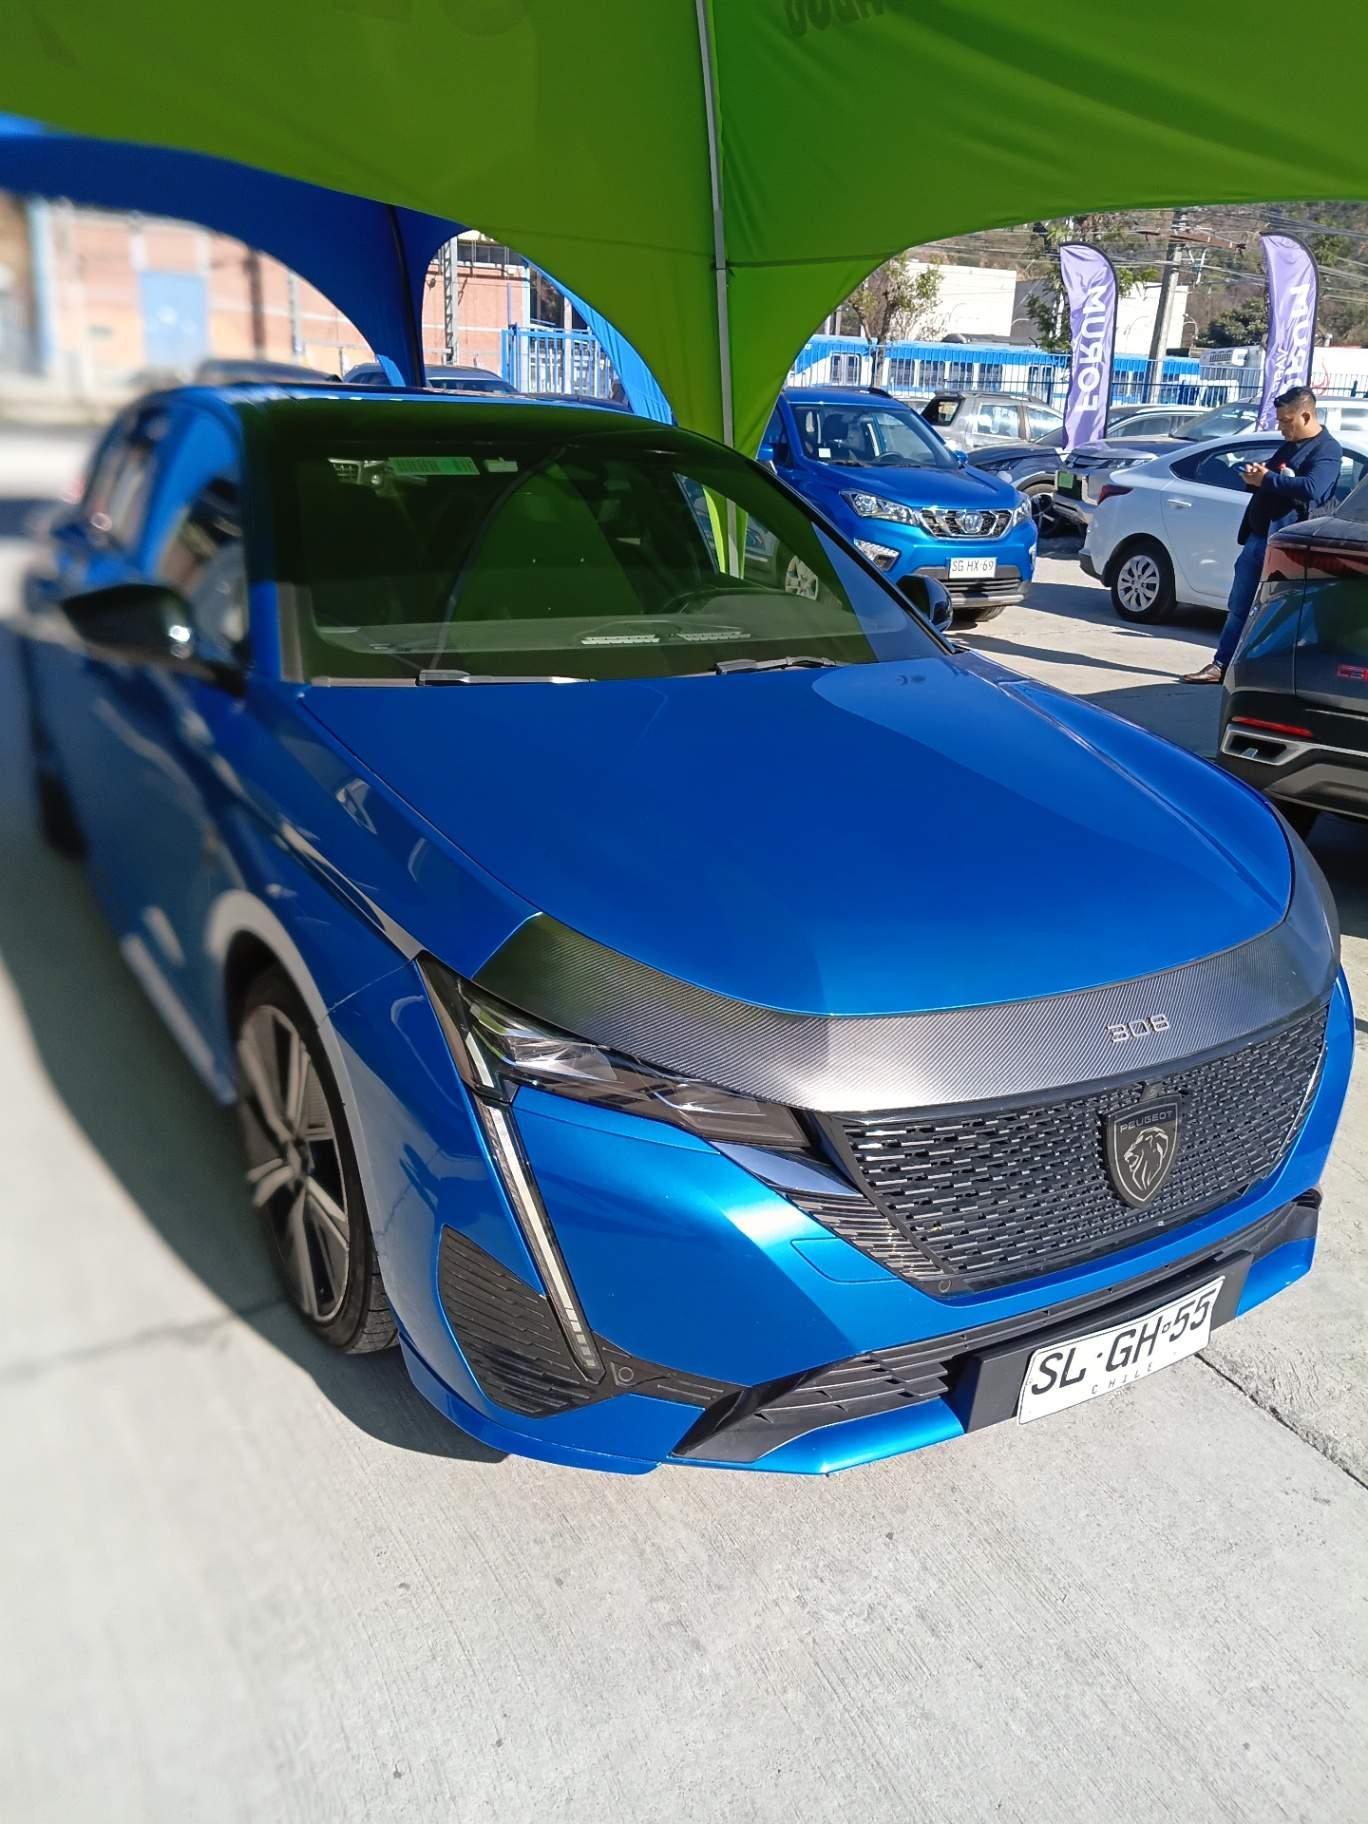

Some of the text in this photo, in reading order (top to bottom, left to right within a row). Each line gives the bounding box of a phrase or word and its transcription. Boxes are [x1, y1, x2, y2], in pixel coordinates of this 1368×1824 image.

[1107, 1014, 1170, 1042] 308
[1120, 1110, 1173, 1133] PEUGEOT
[1091, 1362, 1153, 1395] CHILE
